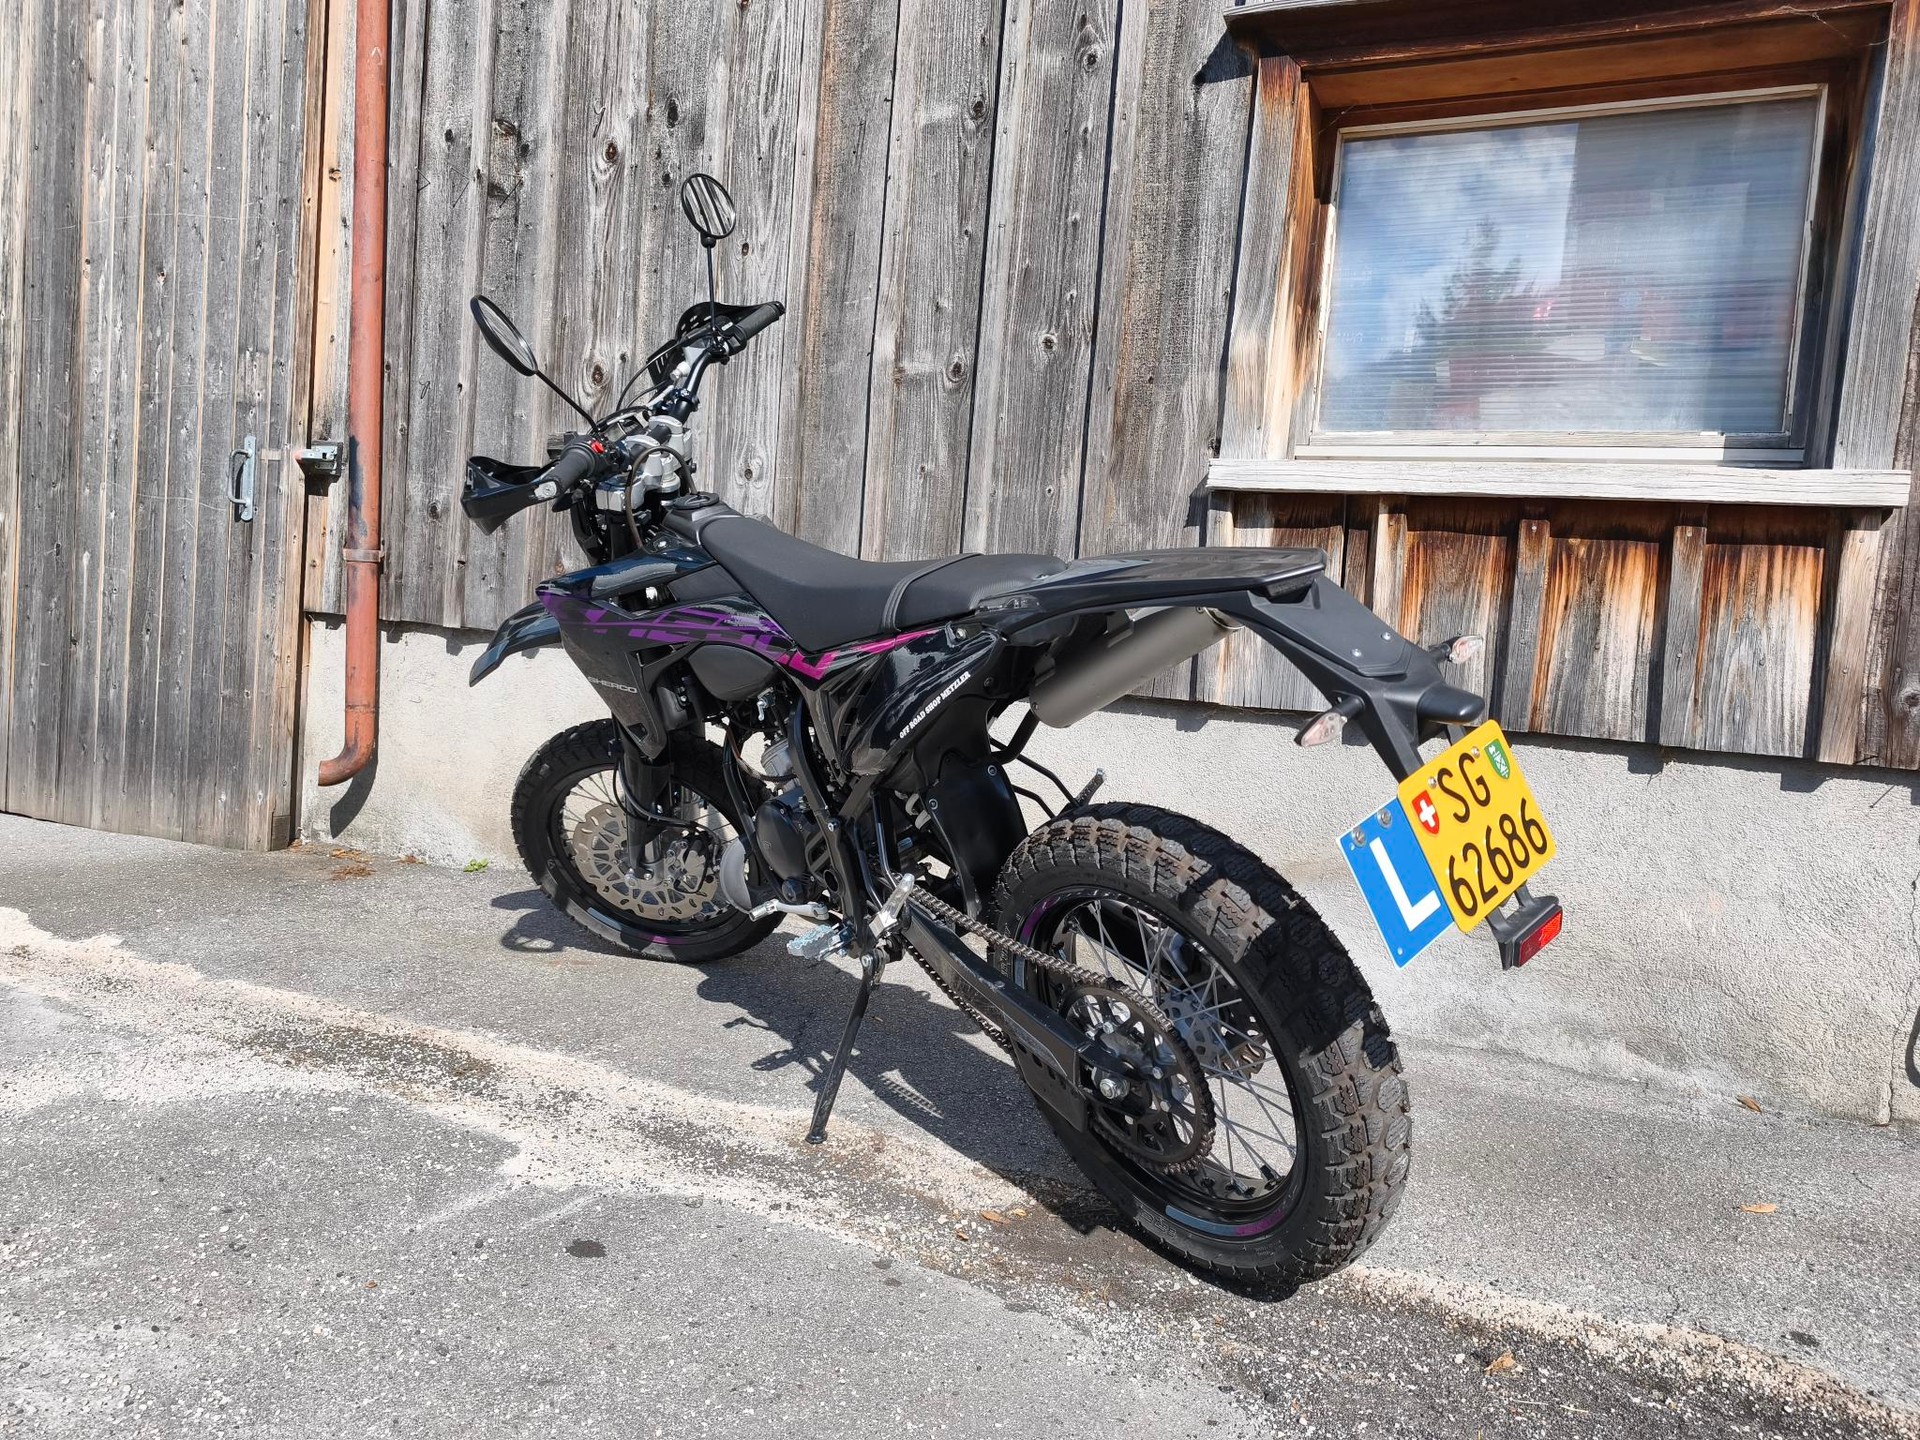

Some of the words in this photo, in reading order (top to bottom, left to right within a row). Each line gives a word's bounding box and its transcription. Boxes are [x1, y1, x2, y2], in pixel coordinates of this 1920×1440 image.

[899, 725, 910, 739] OFF
[909, 710, 926, 729] ROAD
[925, 696, 941, 714] SHOP
[940, 671, 971, 700] METZLER
[1436, 752, 1491, 823] SG
[1369, 836, 1441, 932] L
[1449, 797, 1548, 917] 62686
